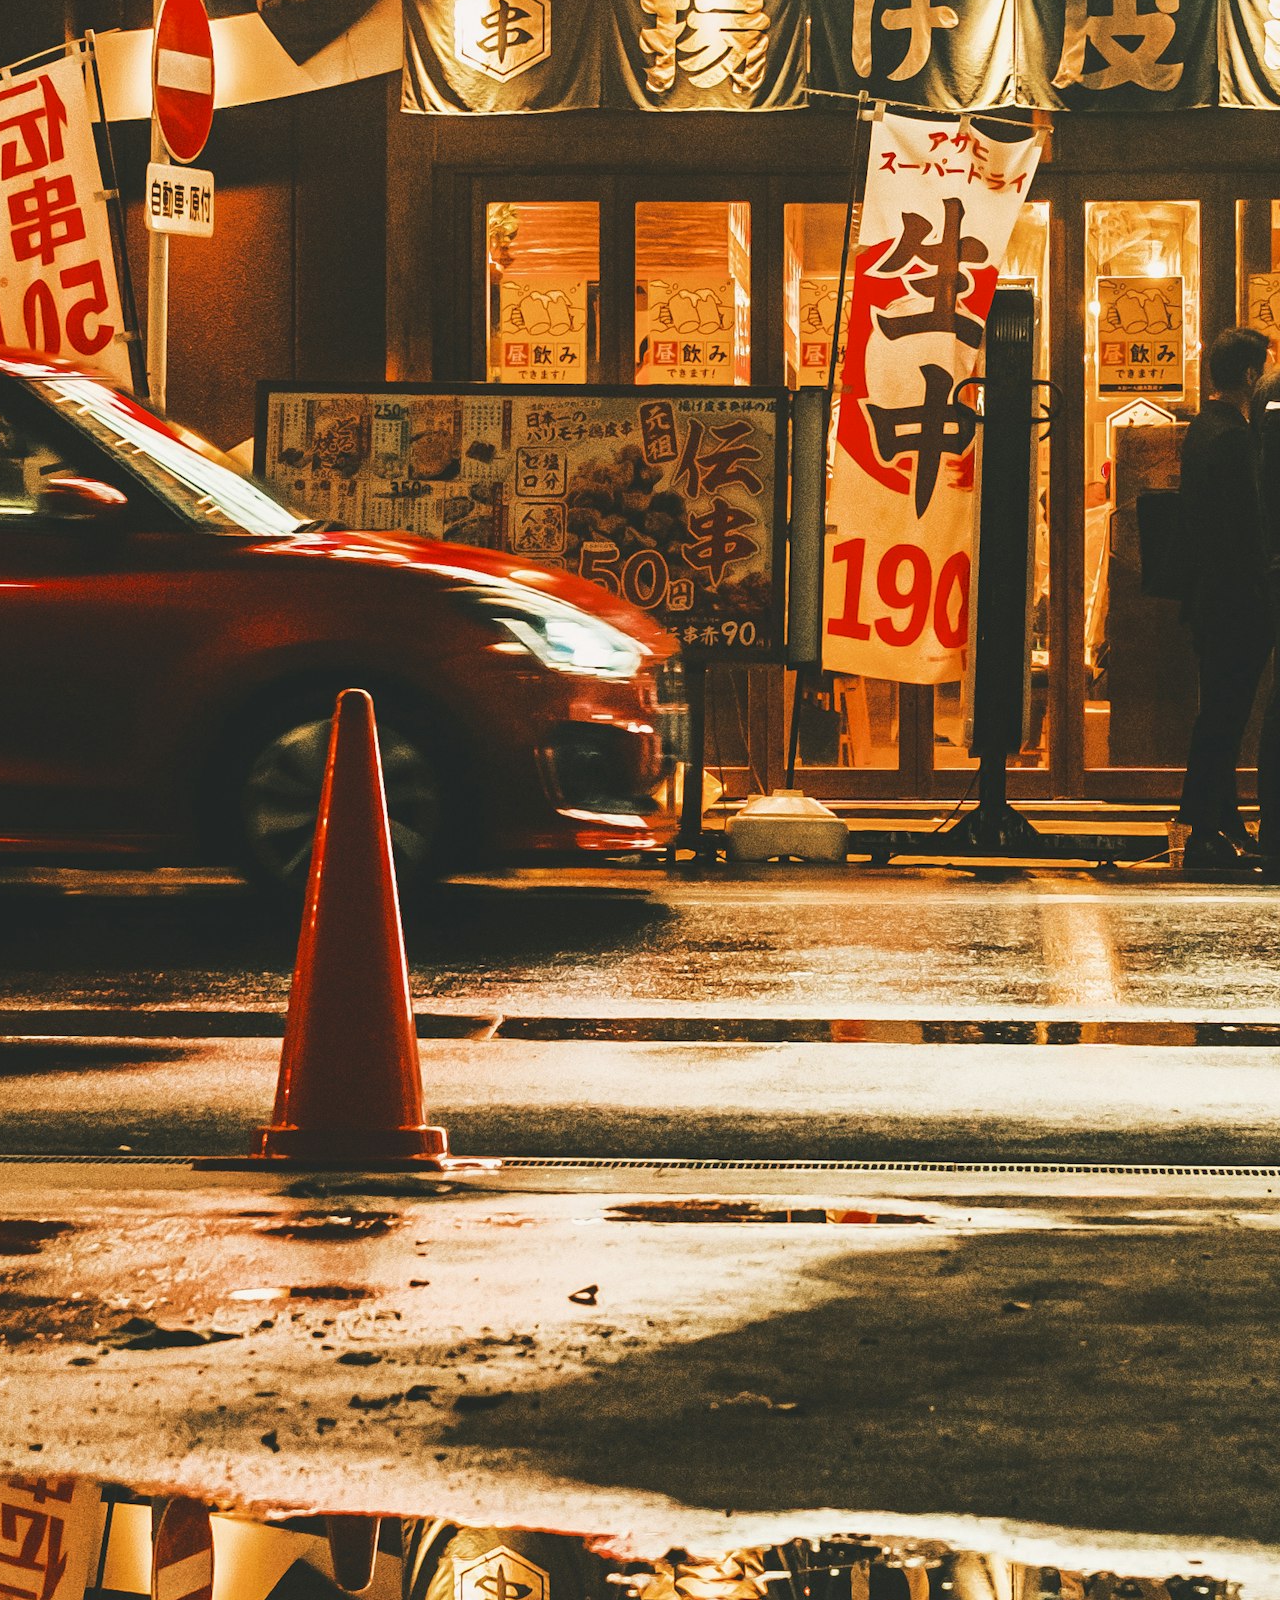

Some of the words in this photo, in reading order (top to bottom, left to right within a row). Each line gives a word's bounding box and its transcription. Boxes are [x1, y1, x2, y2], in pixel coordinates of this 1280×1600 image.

[476, 0, 534, 65] 串
[928, 132, 990, 163] アサヒ
[879, 151, 1028, 194] スーパードライ
[150, 179, 212, 224] 自動車・原付
[505, 343, 580, 367] 昼飲み
[654, 343, 729, 367] 昼飲み
[863, 197, 990, 520] 生中
[1102, 342, 1177, 367] 昼飲み
[526, 410, 587, 429] 日本一の
[644, 406, 677, 460] 元祖
[542, 453, 561, 491] 塩分
[672, 418, 764, 588] 伝串
[827, 537, 971, 649] 190
[721, 620, 756, 647] 90
